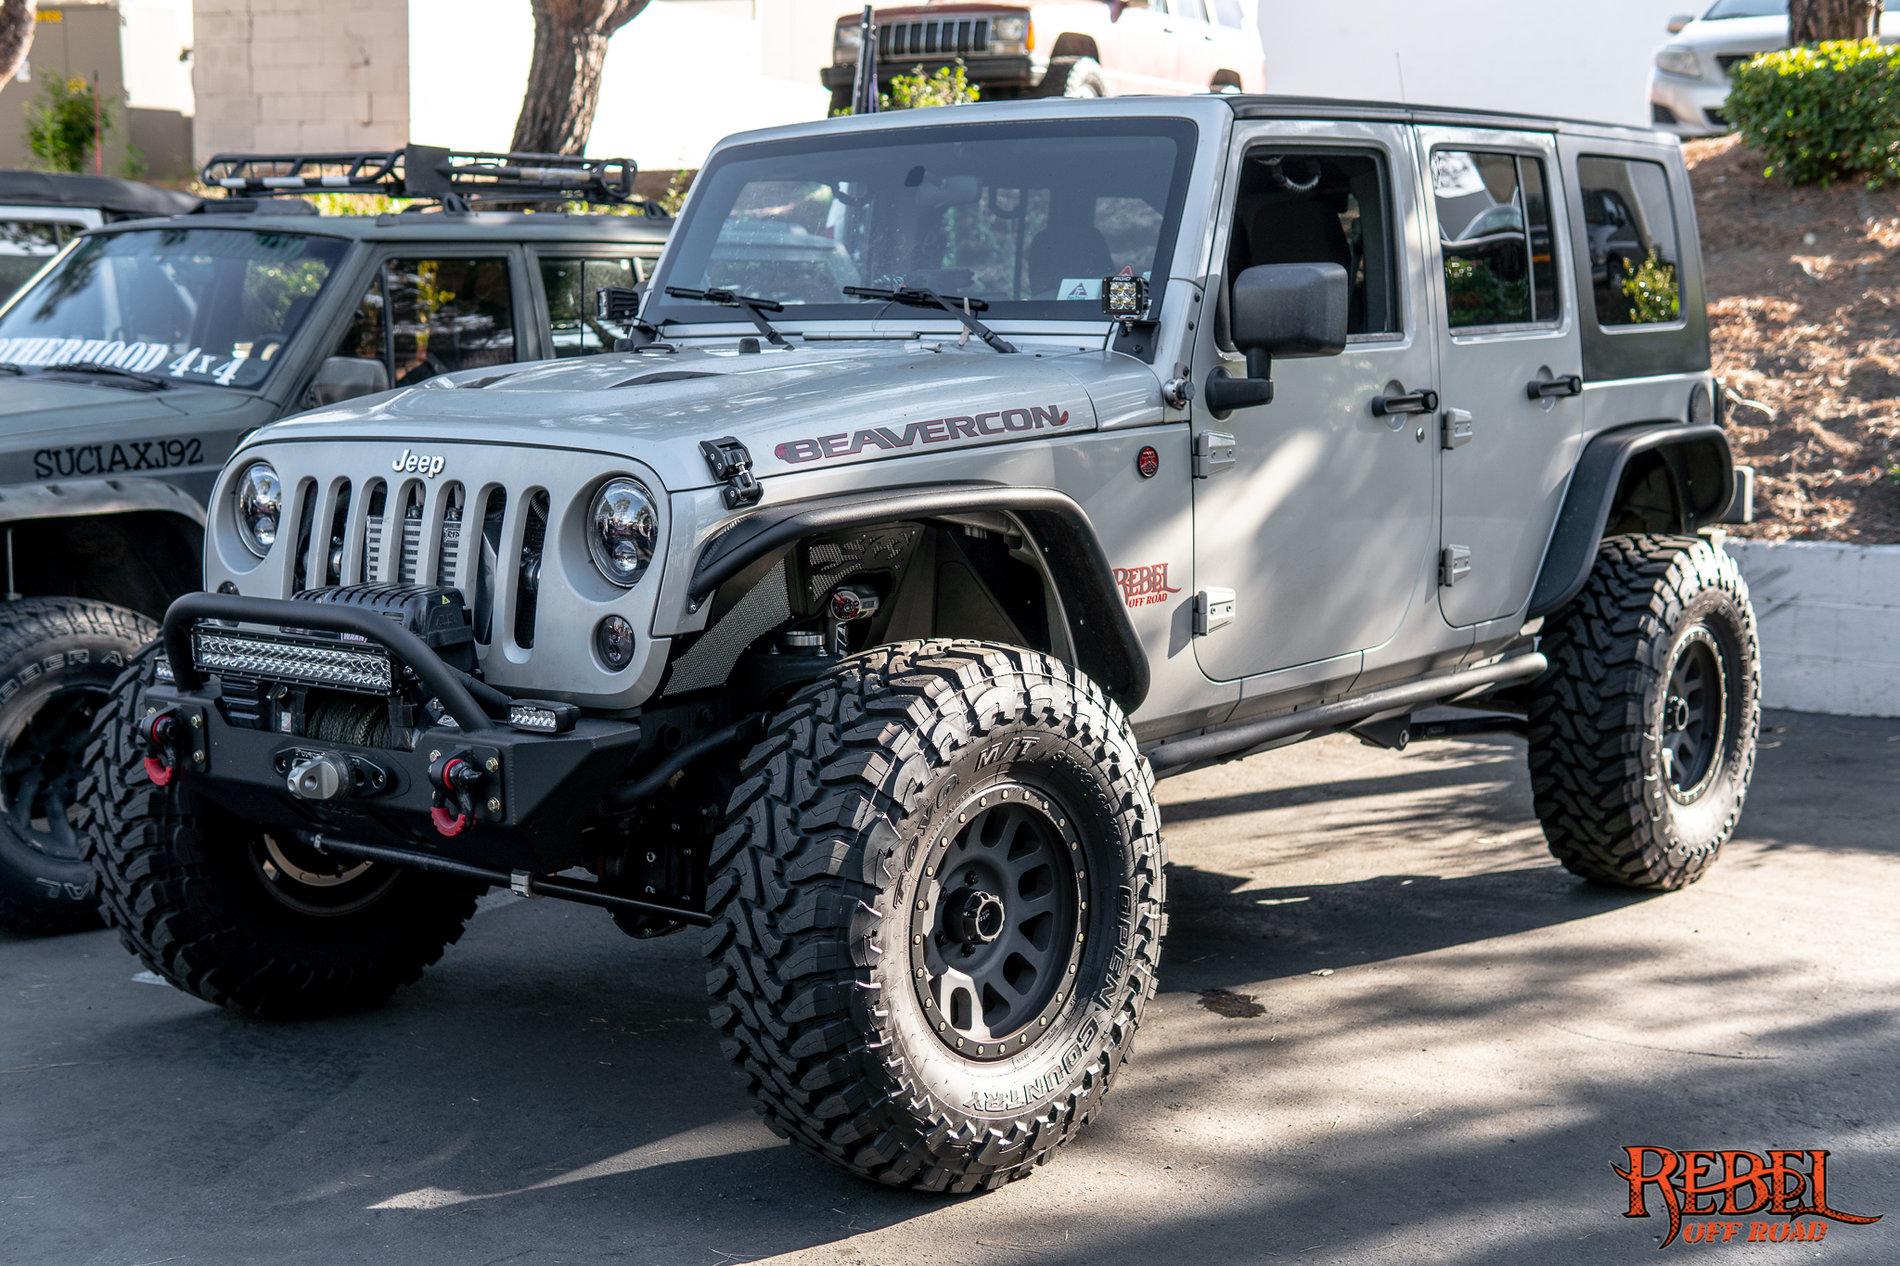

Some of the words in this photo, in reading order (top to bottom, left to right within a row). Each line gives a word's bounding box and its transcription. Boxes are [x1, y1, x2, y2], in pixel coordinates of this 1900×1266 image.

[33, 438, 203, 479] SUCIAXJ92
[778, 405, 1068, 464] BEAVERCON
[392, 448, 445, 479] Jeep
[1113, 563, 1182, 605] REBEL
[1128, 596, 1144, 608] OFF
[1146, 592, 1168, 605] ROAD
[893, 774, 958, 910] TOYO
[973, 736, 1041, 773] M/T
[1099, 884, 1134, 1012] OPEN
[962, 1015, 1100, 1113] COUNTRY
